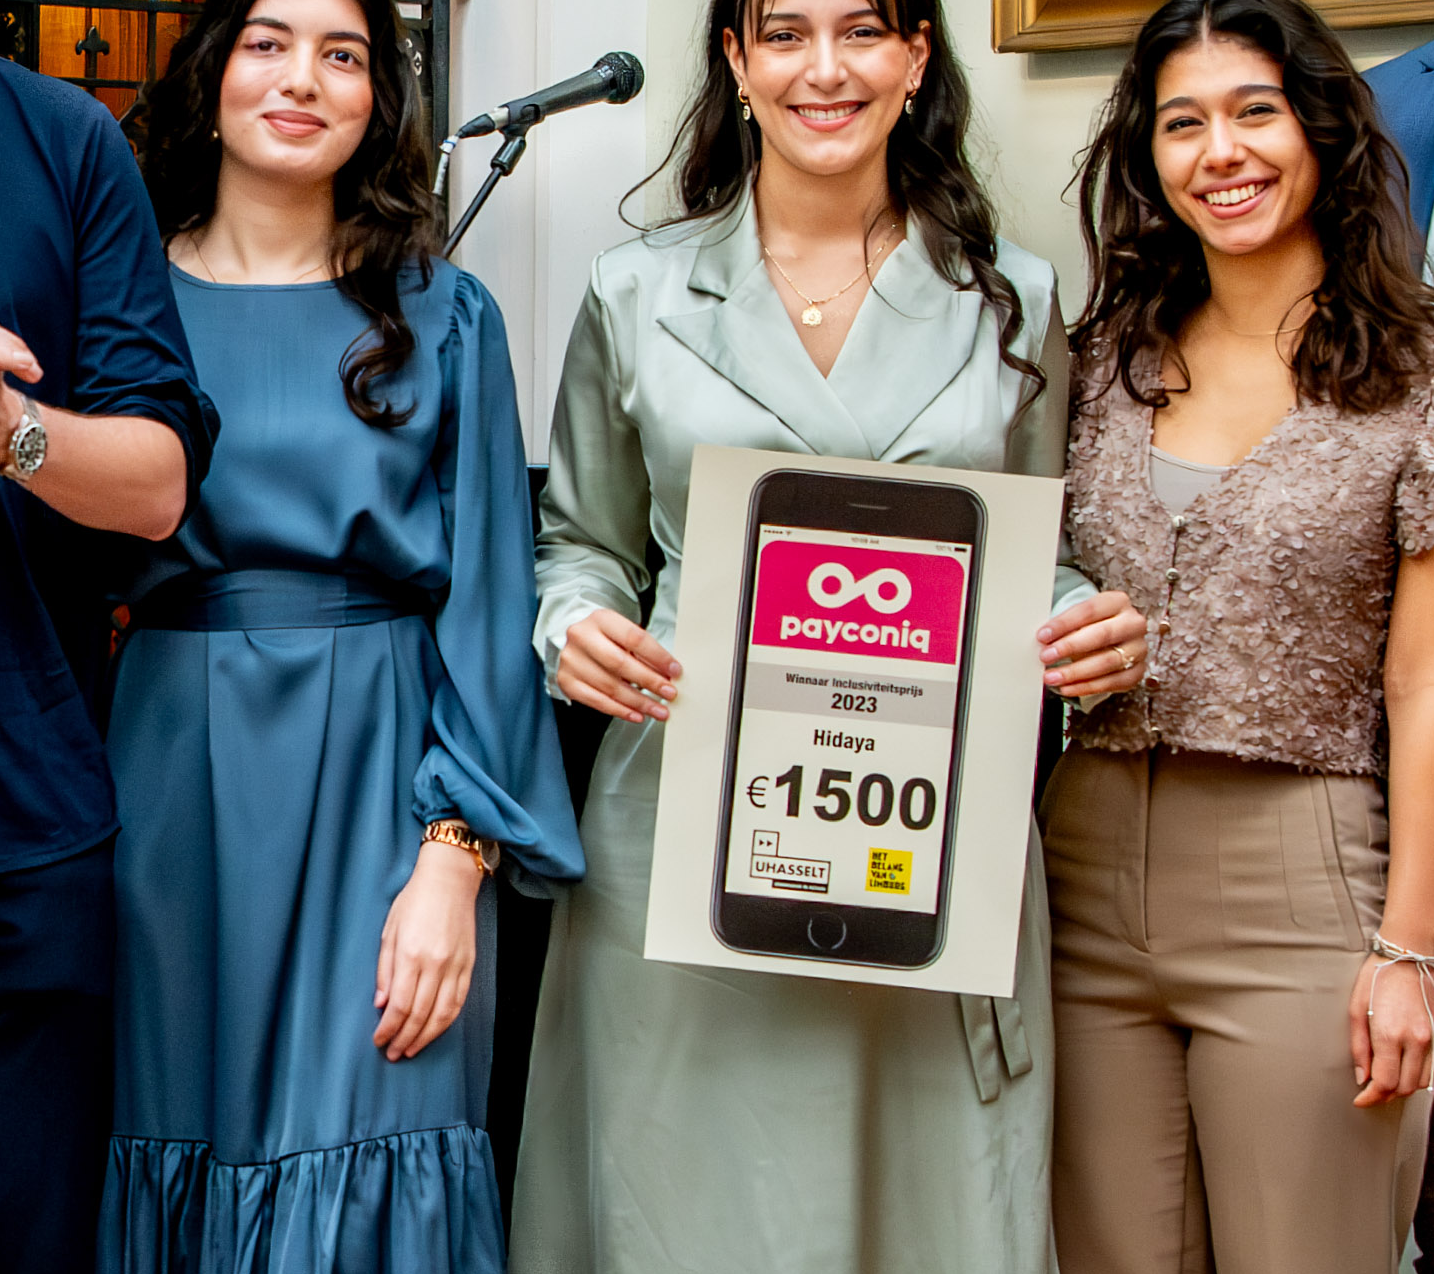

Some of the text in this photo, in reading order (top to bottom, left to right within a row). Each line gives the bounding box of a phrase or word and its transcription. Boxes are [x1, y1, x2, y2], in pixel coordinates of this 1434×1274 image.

[780, 615, 930, 654] payconiq
[785, 672, 923, 698] Winnaar Inclusiviteitsprijs
[831, 693, 878, 713] 2023
[813, 729, 875, 753] Hidaya
[746, 765, 936, 831] €1500
[755, 861, 826, 878] UHASSELT
